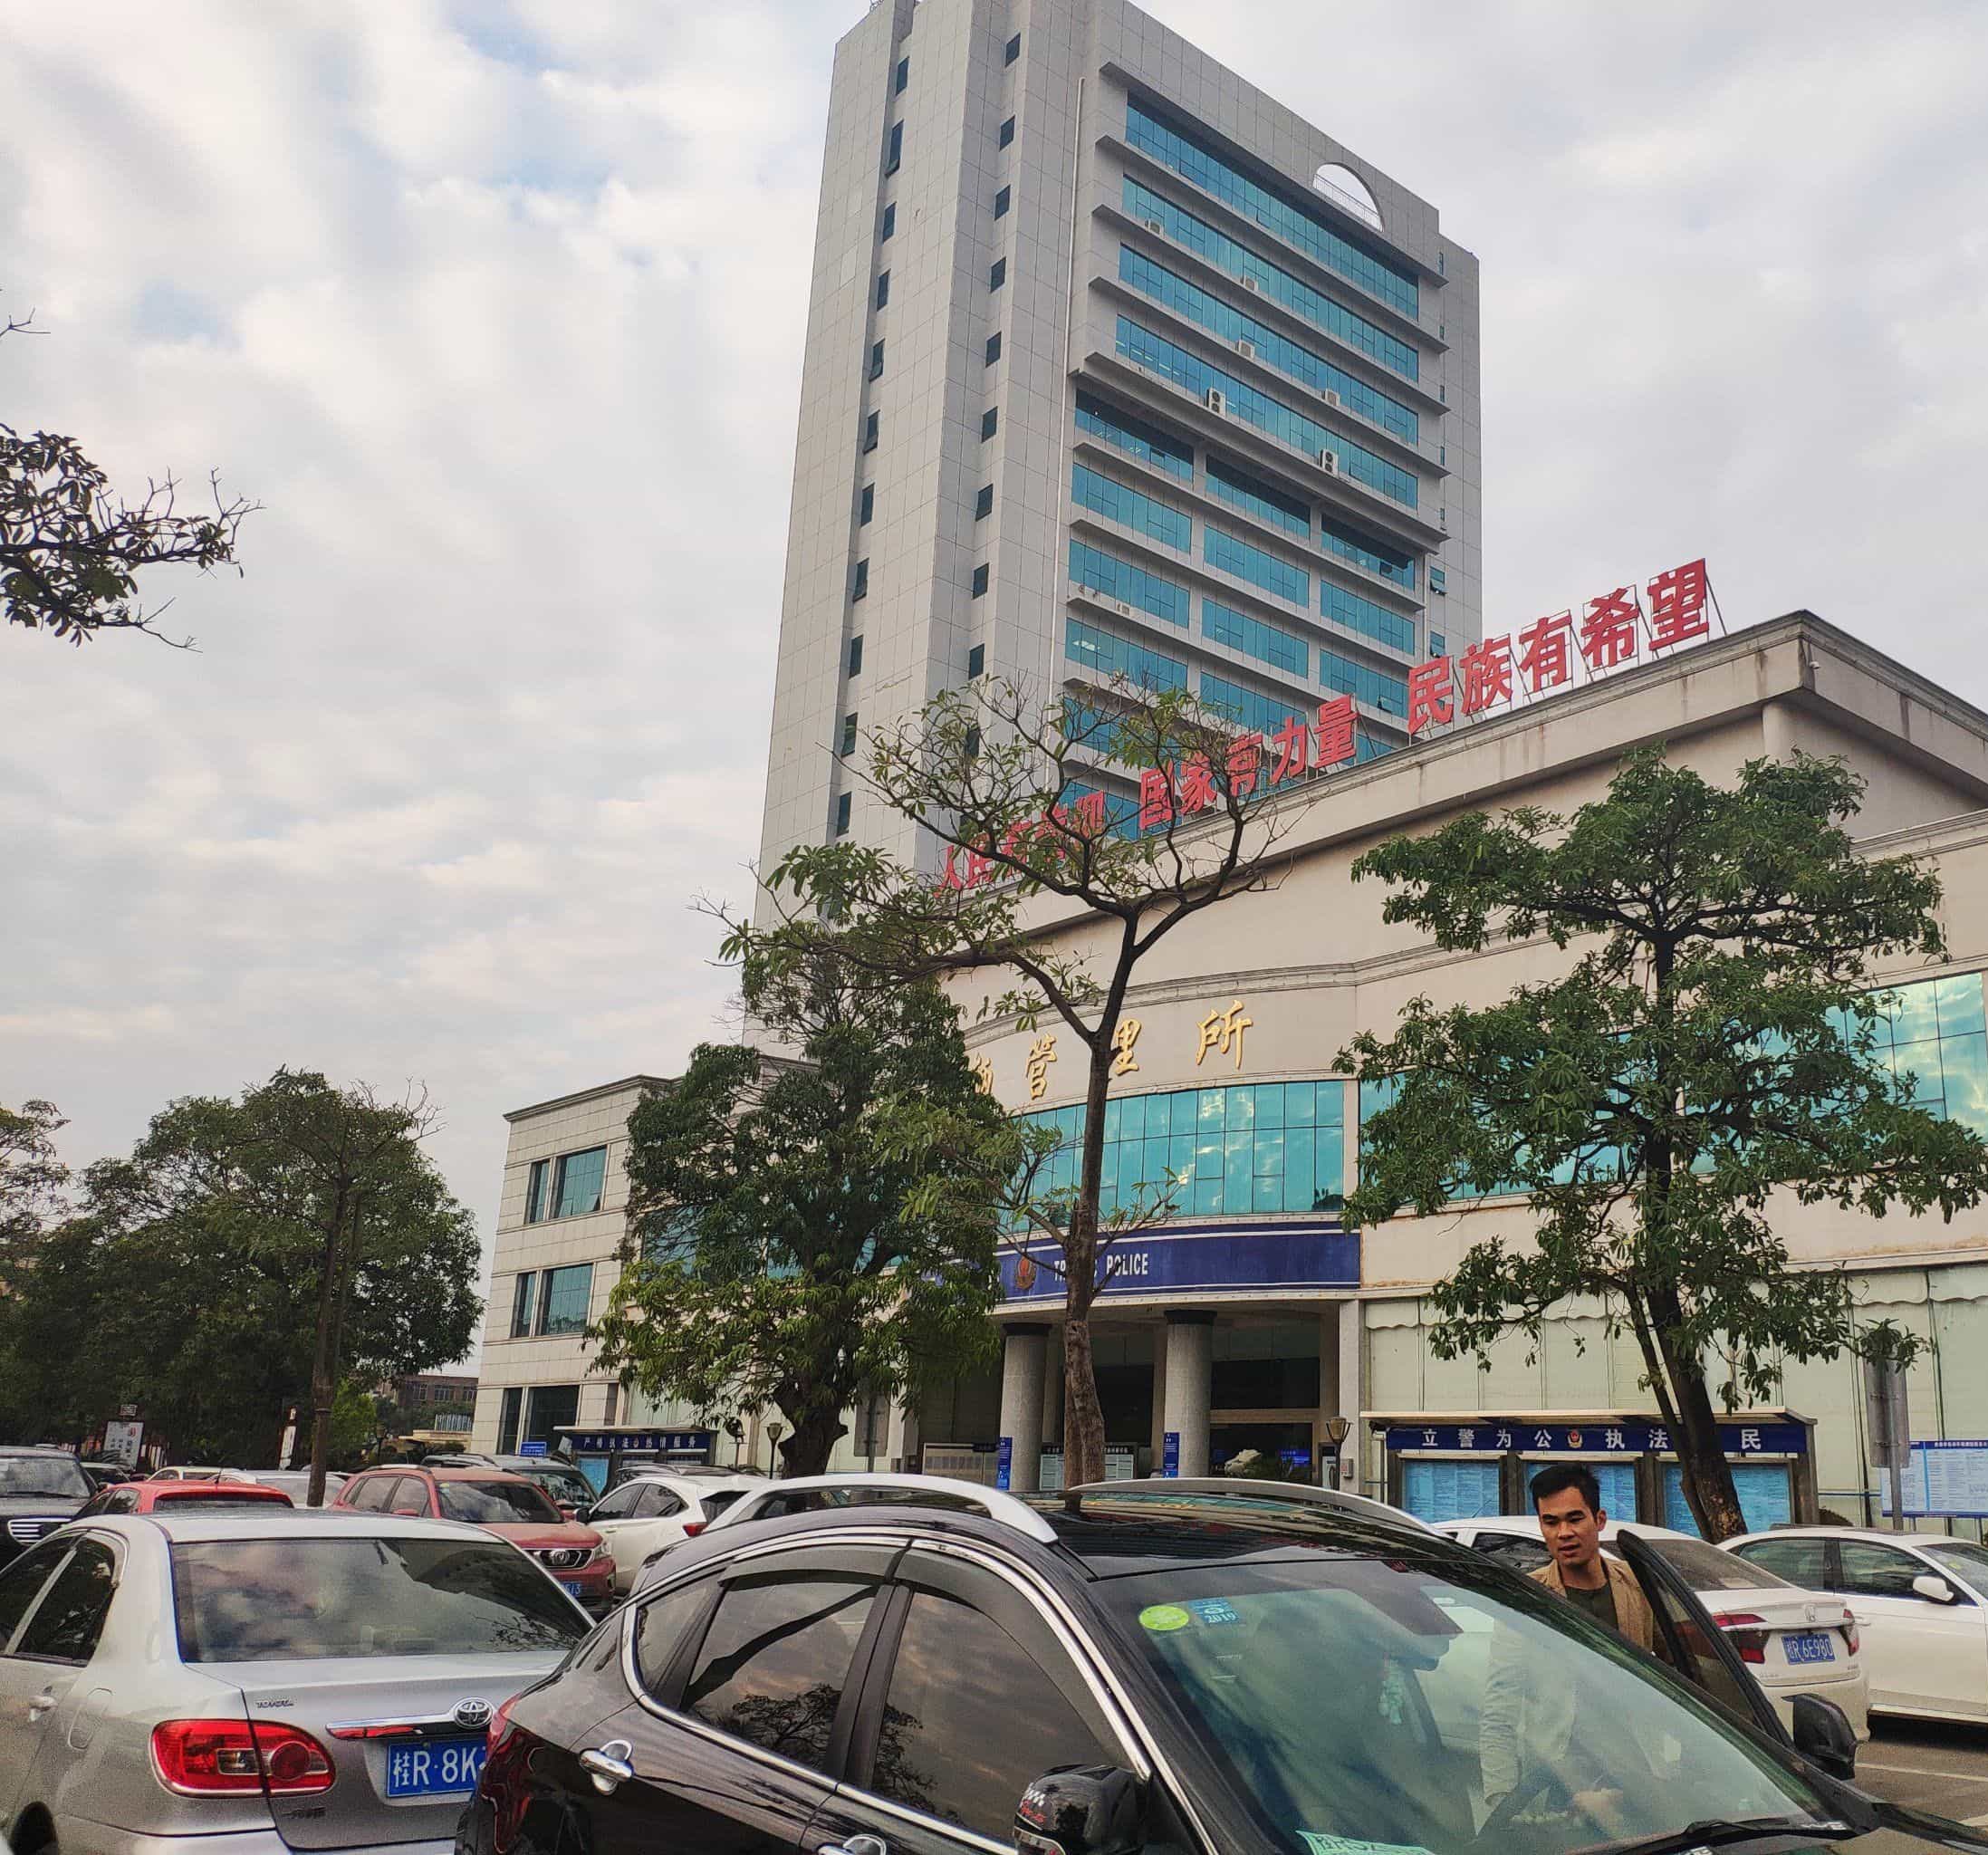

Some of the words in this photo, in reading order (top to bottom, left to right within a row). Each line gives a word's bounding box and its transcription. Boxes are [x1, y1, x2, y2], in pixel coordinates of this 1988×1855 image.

[1408, 558, 1709, 735] 民族有希望
[1107, 1253, 1148, 1277] POLICE
[1422, 1427, 1552, 1448] 立警为公
[1606, 1428, 1762, 1449] 执法民
[393, 1744, 486, 1788] 桂R·8K
